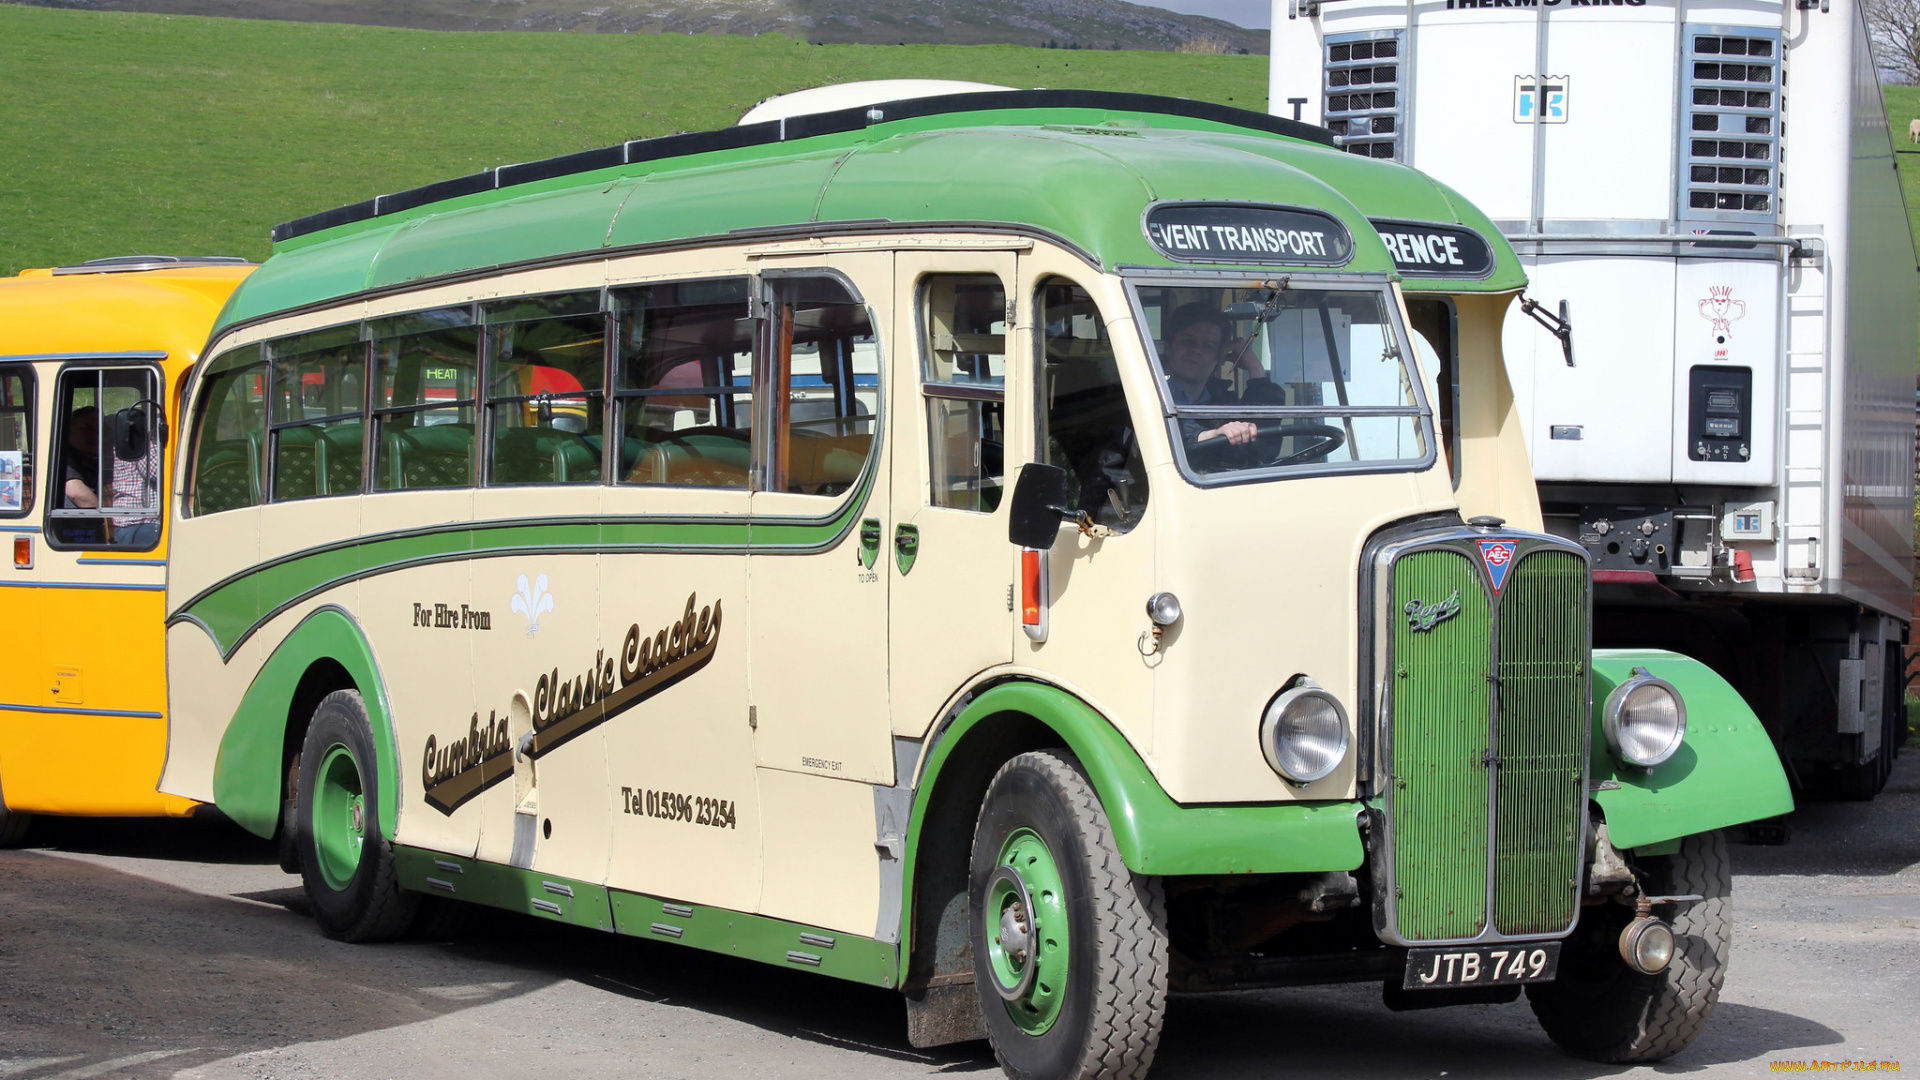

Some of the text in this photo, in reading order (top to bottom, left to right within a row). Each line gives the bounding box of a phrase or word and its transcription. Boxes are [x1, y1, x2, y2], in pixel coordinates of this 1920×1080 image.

[1212, 225, 1328, 257] TRANSPORT
[1378, 232, 1464, 265] RENCE
[1486, 551, 1510, 560] AEC
[858, 573, 878, 583] TO OPEN
[413, 602, 491, 630] For Hire From
[1405, 590, 1461, 631] Regal
[423, 591, 722, 792] Cumbria Classic Coaches
[802, 756, 842, 772] EMERGENCY EXIT
[621, 786, 736, 830] Tel 015396 23254
[1419, 949, 1547, 984] JTB 749
